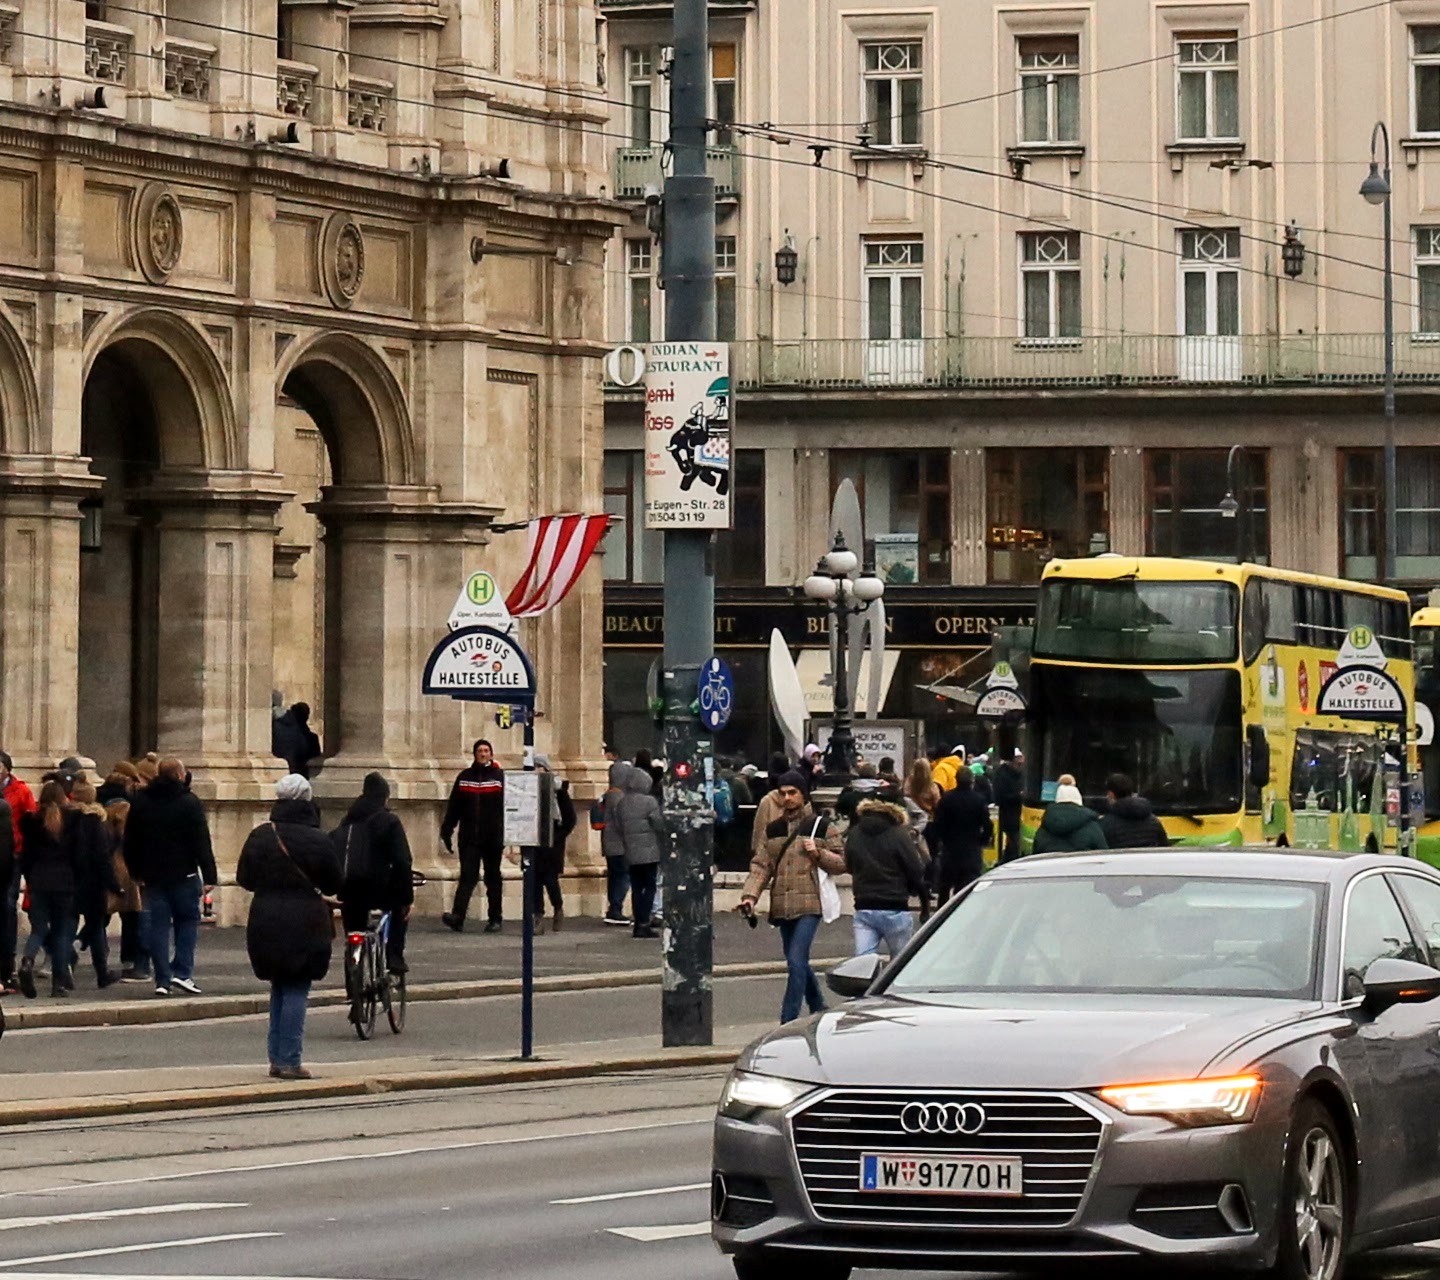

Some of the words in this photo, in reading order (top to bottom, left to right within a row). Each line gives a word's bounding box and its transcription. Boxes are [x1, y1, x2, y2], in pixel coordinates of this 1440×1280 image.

[652, 344, 699, 356] INDIAN
[645, 360, 723, 372] ESTAURANT
[646, 381, 674, 402] emi
[712, 500, 726, 510] 28
[473, 579, 488, 599] H
[605, 616, 664, 631] BEAUT
[1355, 630, 1366, 644] H
[451, 636, 510, 660] AUTOBUS
[439, 672, 520, 685] HALTESTELLE
[1338, 672, 1387, 691] AUTOBUS
[1329, 699, 1395, 709] HALTESTELLE
[883, 1162, 899, 1186] W
[919, 1162, 990, 1189] 91770
[998, 1165, 1011, 1189] H
